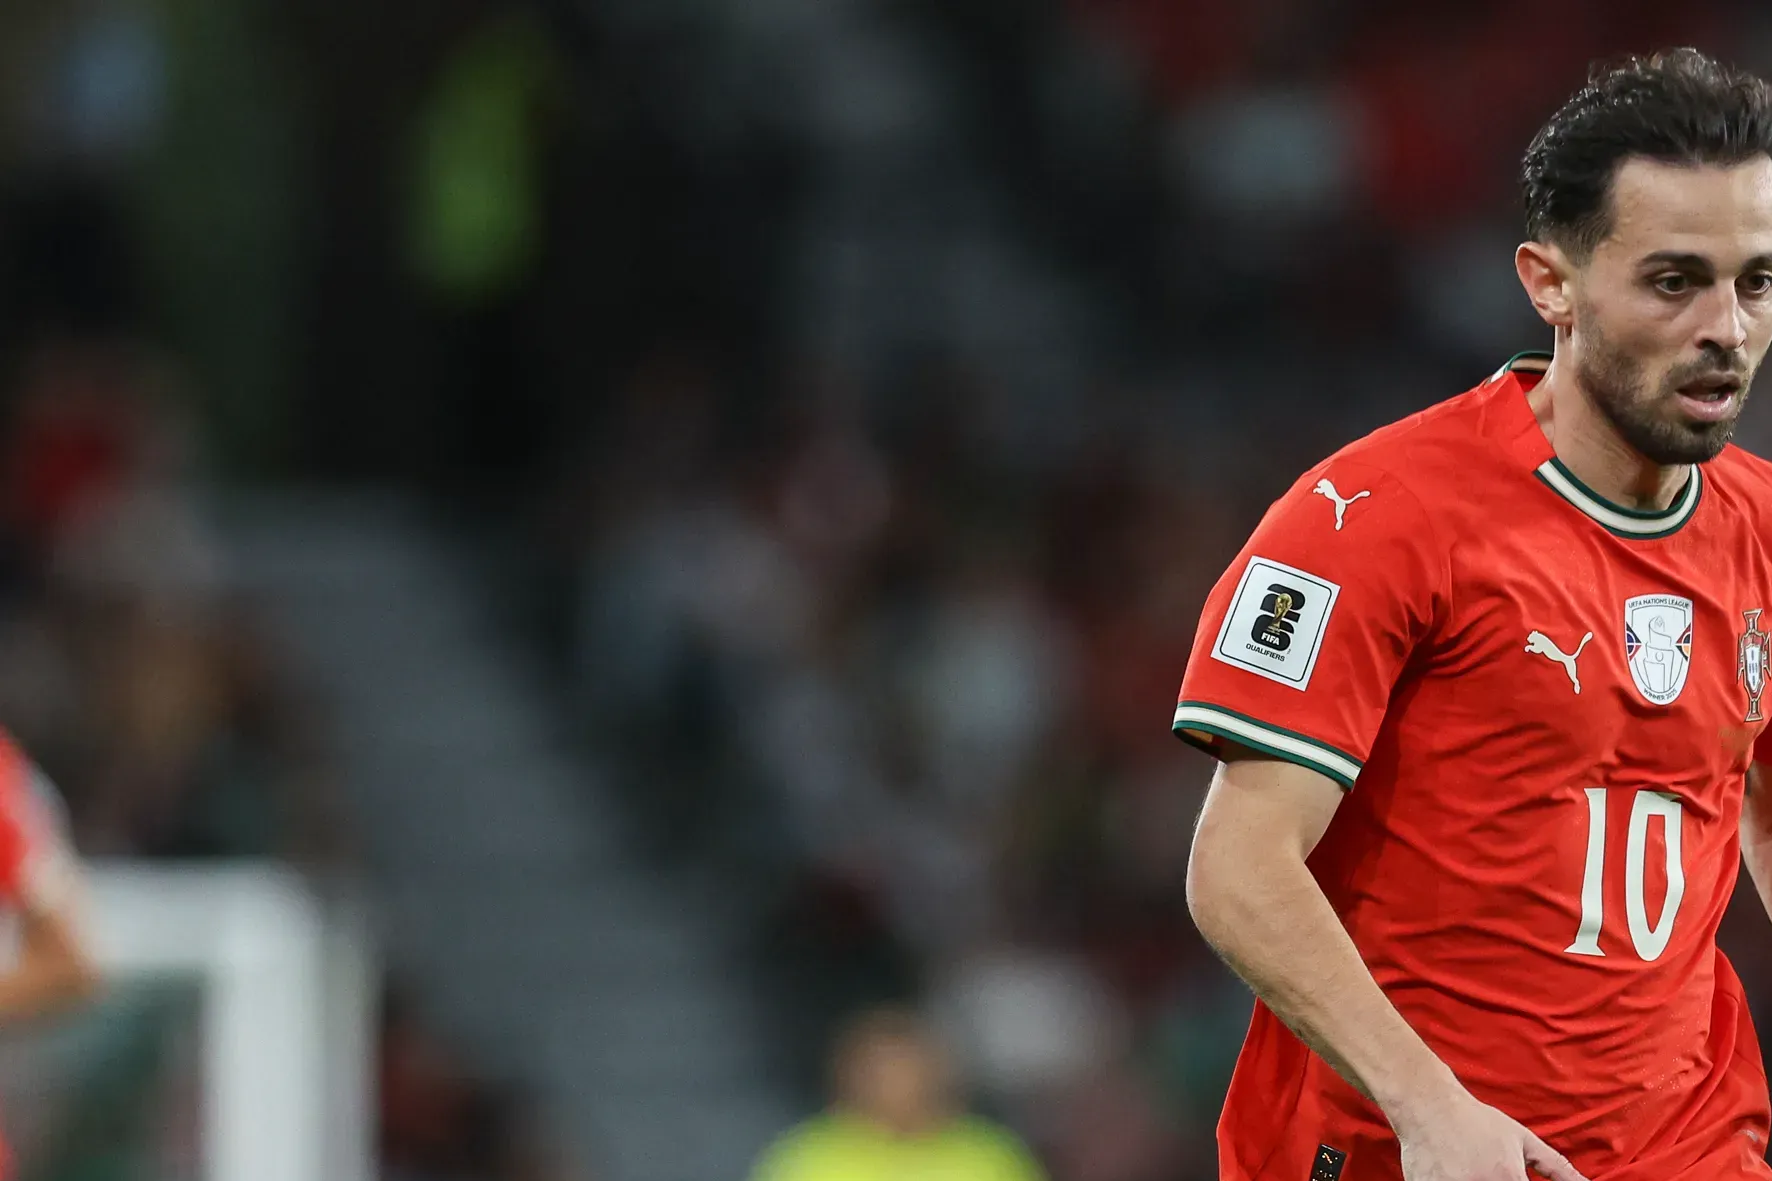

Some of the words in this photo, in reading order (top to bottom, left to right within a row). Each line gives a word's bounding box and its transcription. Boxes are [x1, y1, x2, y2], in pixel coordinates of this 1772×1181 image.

[1628, 599, 1643, 609] UEFA
[1668, 598, 1690, 609] LEAGUE
[1260, 632, 1281, 646] FIFA
[1245, 643, 1286, 662] QUALIFIERS
[1563, 787, 1686, 962] 10
